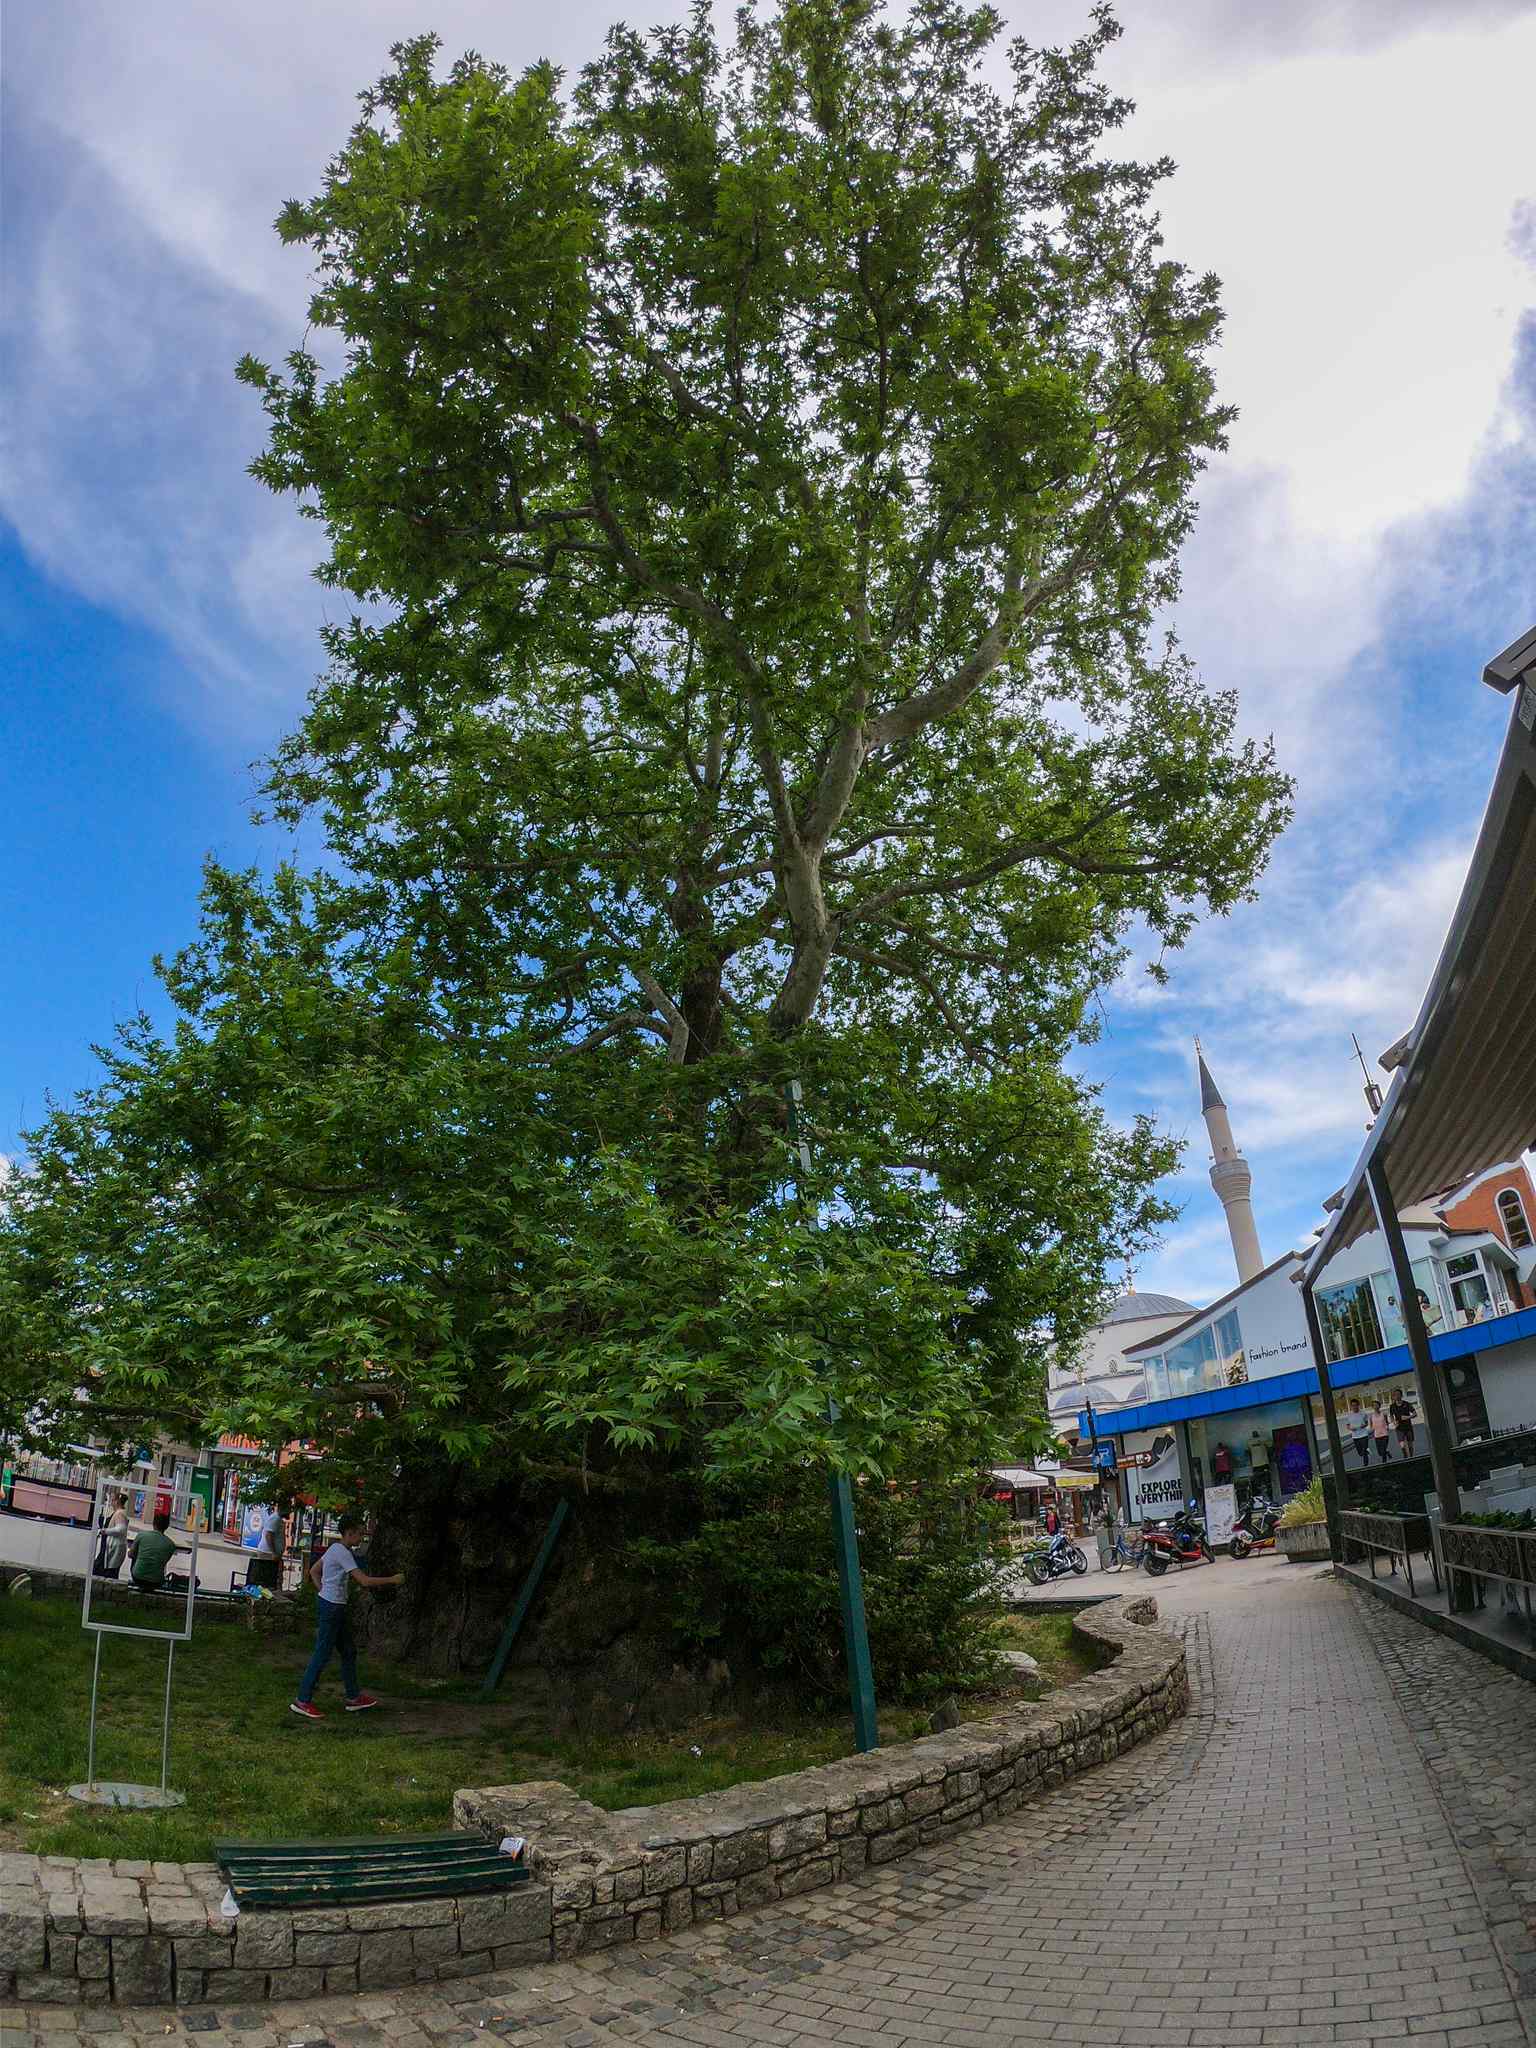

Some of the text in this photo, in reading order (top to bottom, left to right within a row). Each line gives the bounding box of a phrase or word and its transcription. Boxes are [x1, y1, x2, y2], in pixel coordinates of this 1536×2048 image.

[1250, 1336, 1307, 1363] fashion brand
[1141, 1478, 1183, 1494] EXPLORE
